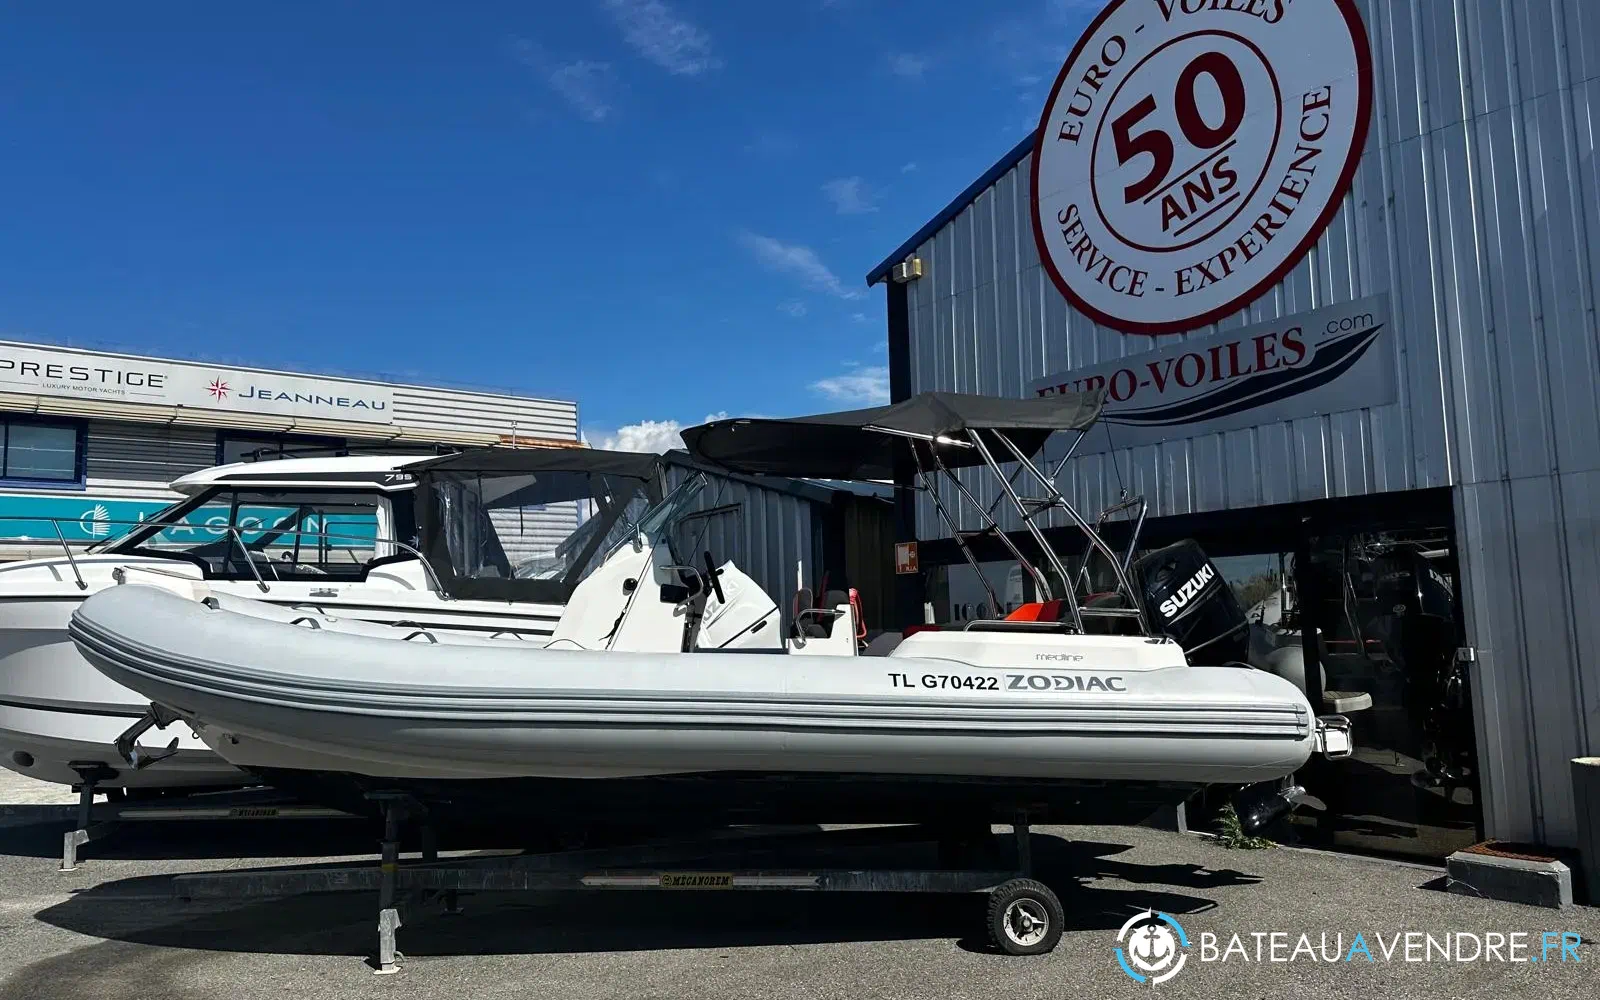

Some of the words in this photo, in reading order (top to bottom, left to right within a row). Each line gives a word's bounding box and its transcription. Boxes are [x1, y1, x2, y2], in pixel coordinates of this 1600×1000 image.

[1057, 35, 1126, 146] EURO
[1111, 51, 1246, 204] 50
[1057, 203, 1148, 298] SERVICE
[1174, 85, 1333, 297] EXPERIENCE
[1161, 155, 1239, 232] ANS
[1321, 311, 1374, 336] .com
[0, 359, 164, 388] PRESTIGE
[42, 382, 71, 390] LUXURY
[72, 385, 98, 393] MOTOR
[238, 385, 385, 411] JEANNEAU
[1159, 563, 1215, 618] SUZUKI
[888, 673, 915, 688] TL
[921, 674, 1000, 691] G70422
[1006, 674, 1127, 692] ZODIAC
